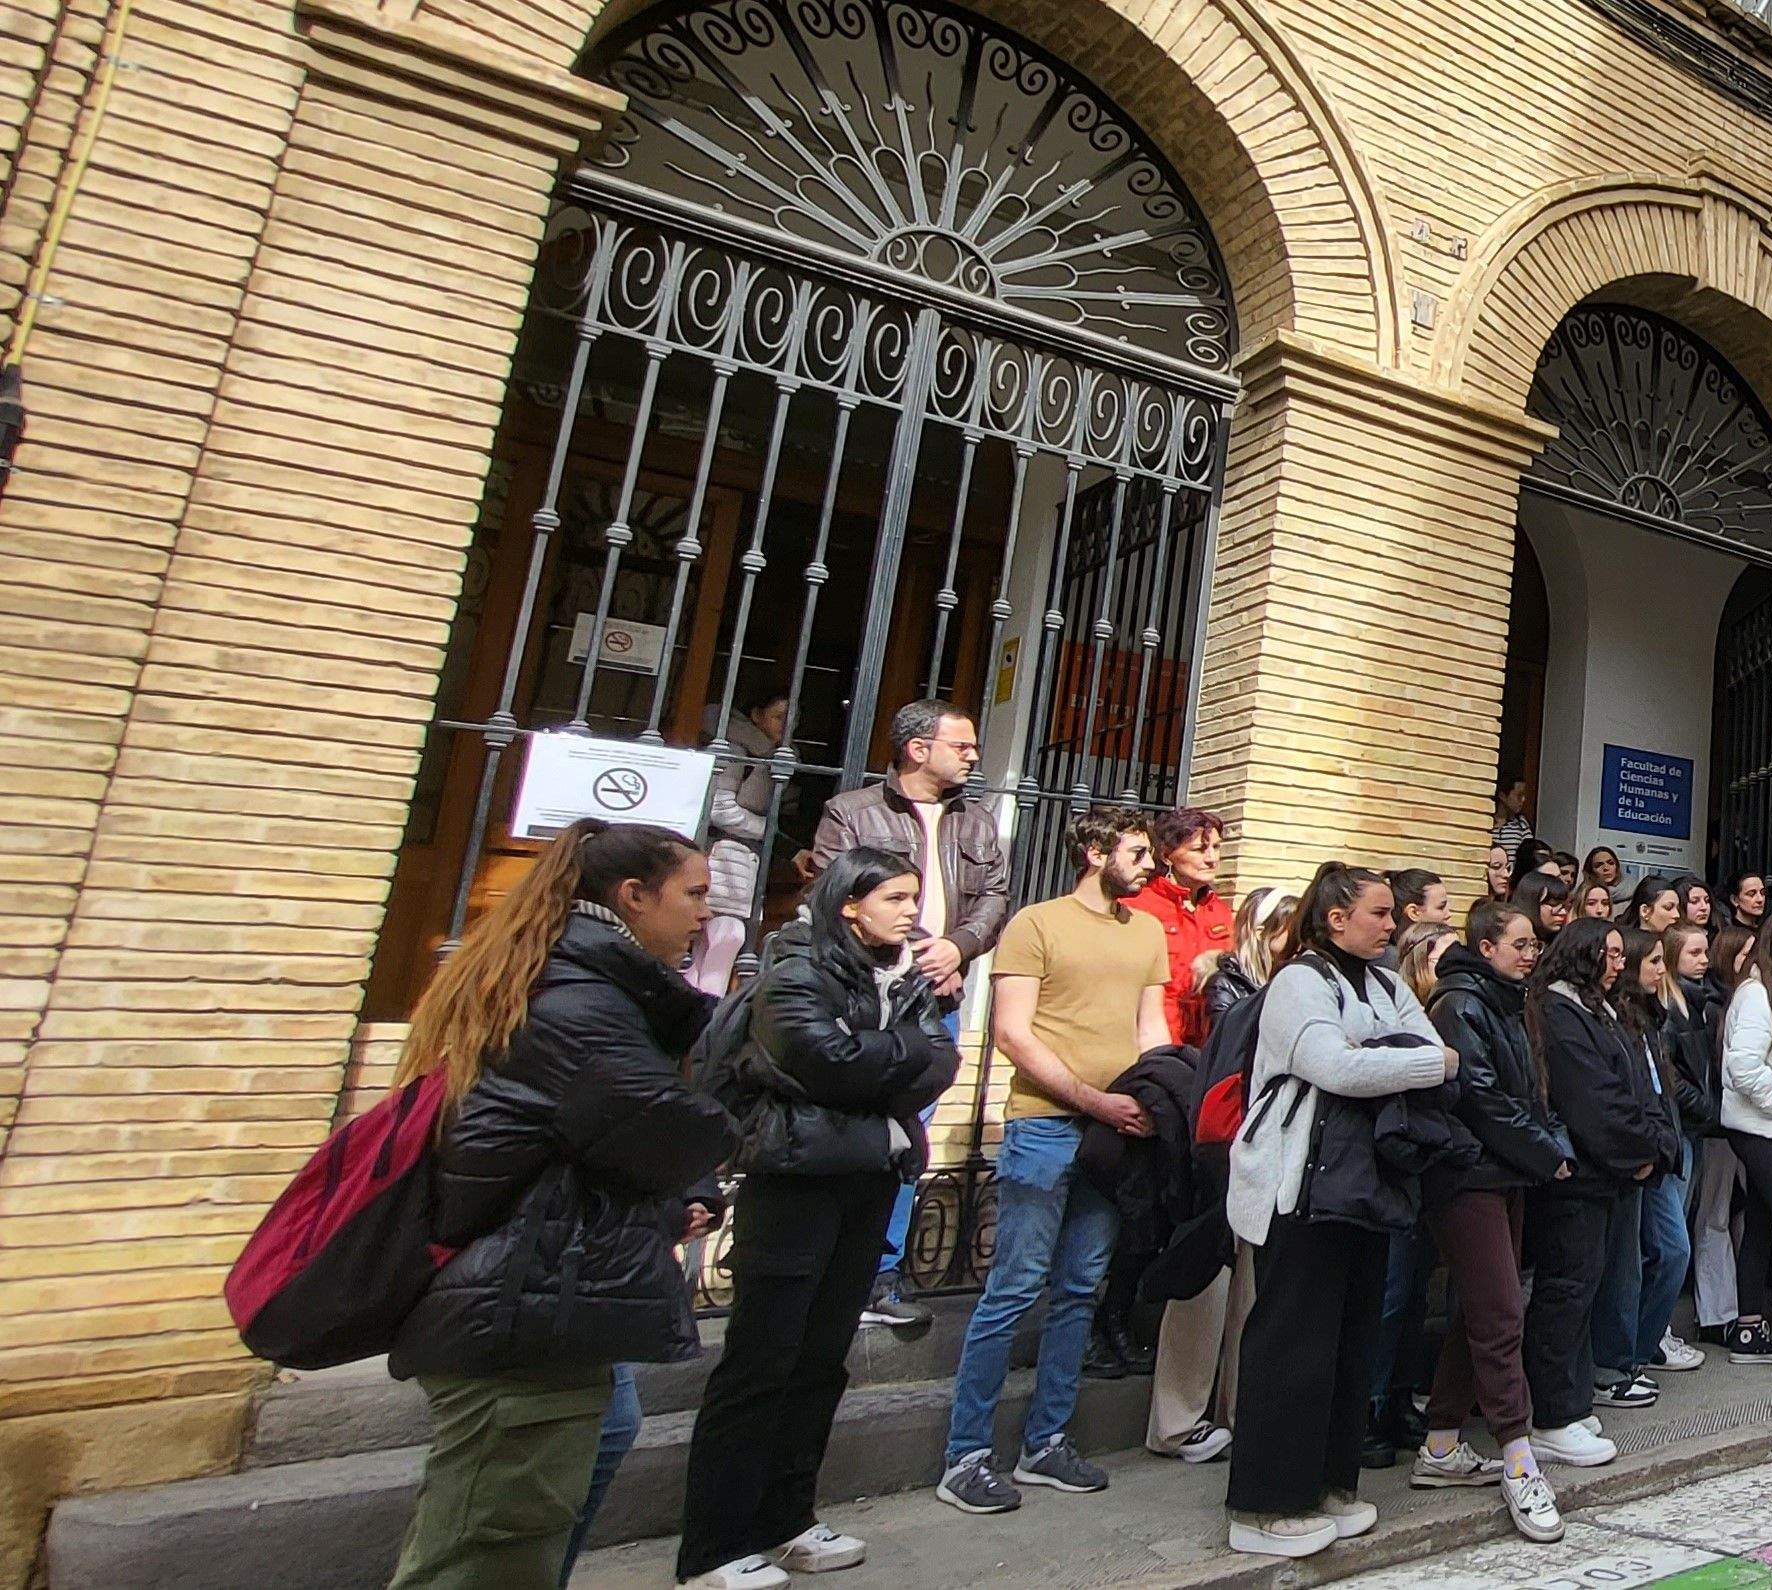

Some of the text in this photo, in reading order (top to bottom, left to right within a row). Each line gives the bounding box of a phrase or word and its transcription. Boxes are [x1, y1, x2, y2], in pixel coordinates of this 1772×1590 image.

[1620, 757, 1682, 777] Facultad de
[1620, 770, 1665, 787] Ciencias
[1619, 782, 1679, 803] Humanas y
[1618, 795, 1645, 808] de la
[1618, 808, 1672, 825] Educación
